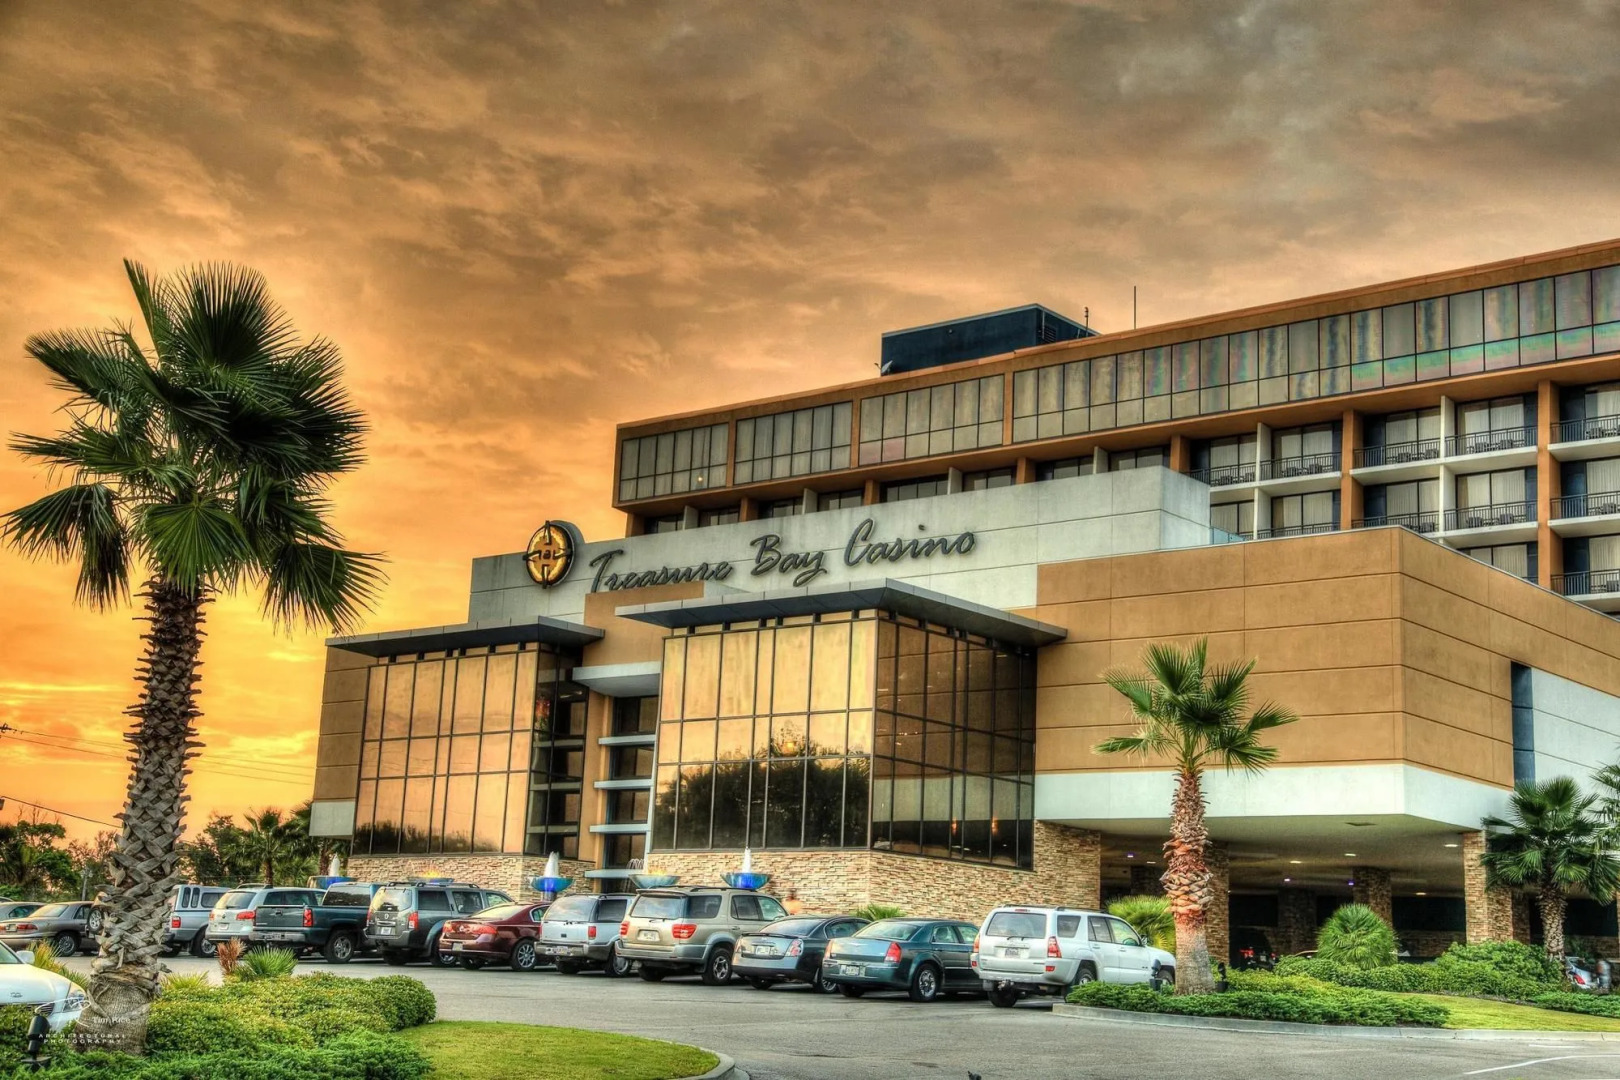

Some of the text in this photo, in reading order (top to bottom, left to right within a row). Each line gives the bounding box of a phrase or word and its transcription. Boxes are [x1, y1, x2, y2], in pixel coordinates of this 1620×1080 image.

[589, 518, 975, 592] Treasure Bay Casino
